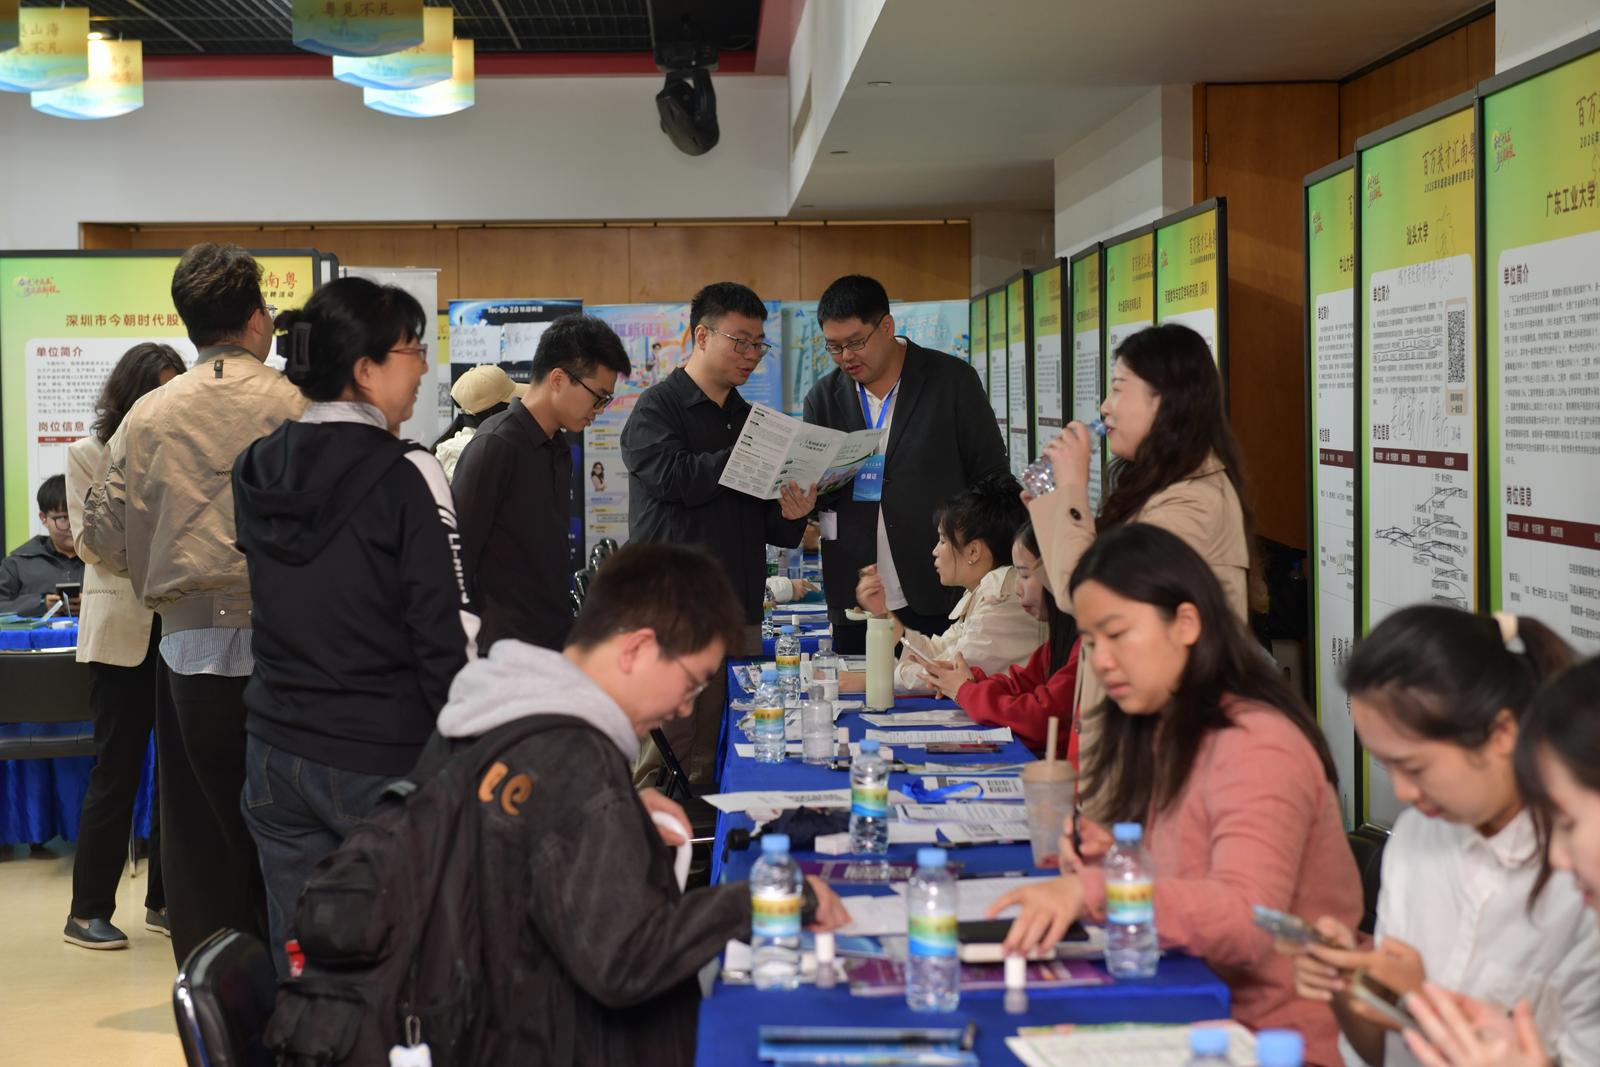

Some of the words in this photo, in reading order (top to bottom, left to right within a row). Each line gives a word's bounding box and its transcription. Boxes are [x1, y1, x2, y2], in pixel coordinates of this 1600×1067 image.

[1576, 91, 1600, 128] 百万
[1545, 181, 1596, 217] 广东工业大学
[1406, 221, 1429, 246] 汕头大学
[259, 271, 298, 289] 南粤
[1503, 263, 1530, 286] 单位简介
[66, 313, 186, 327] 深圳市今朝时代股
[36, 346, 83, 358] 单位简介
[38, 421, 85, 433] 岗位信息
